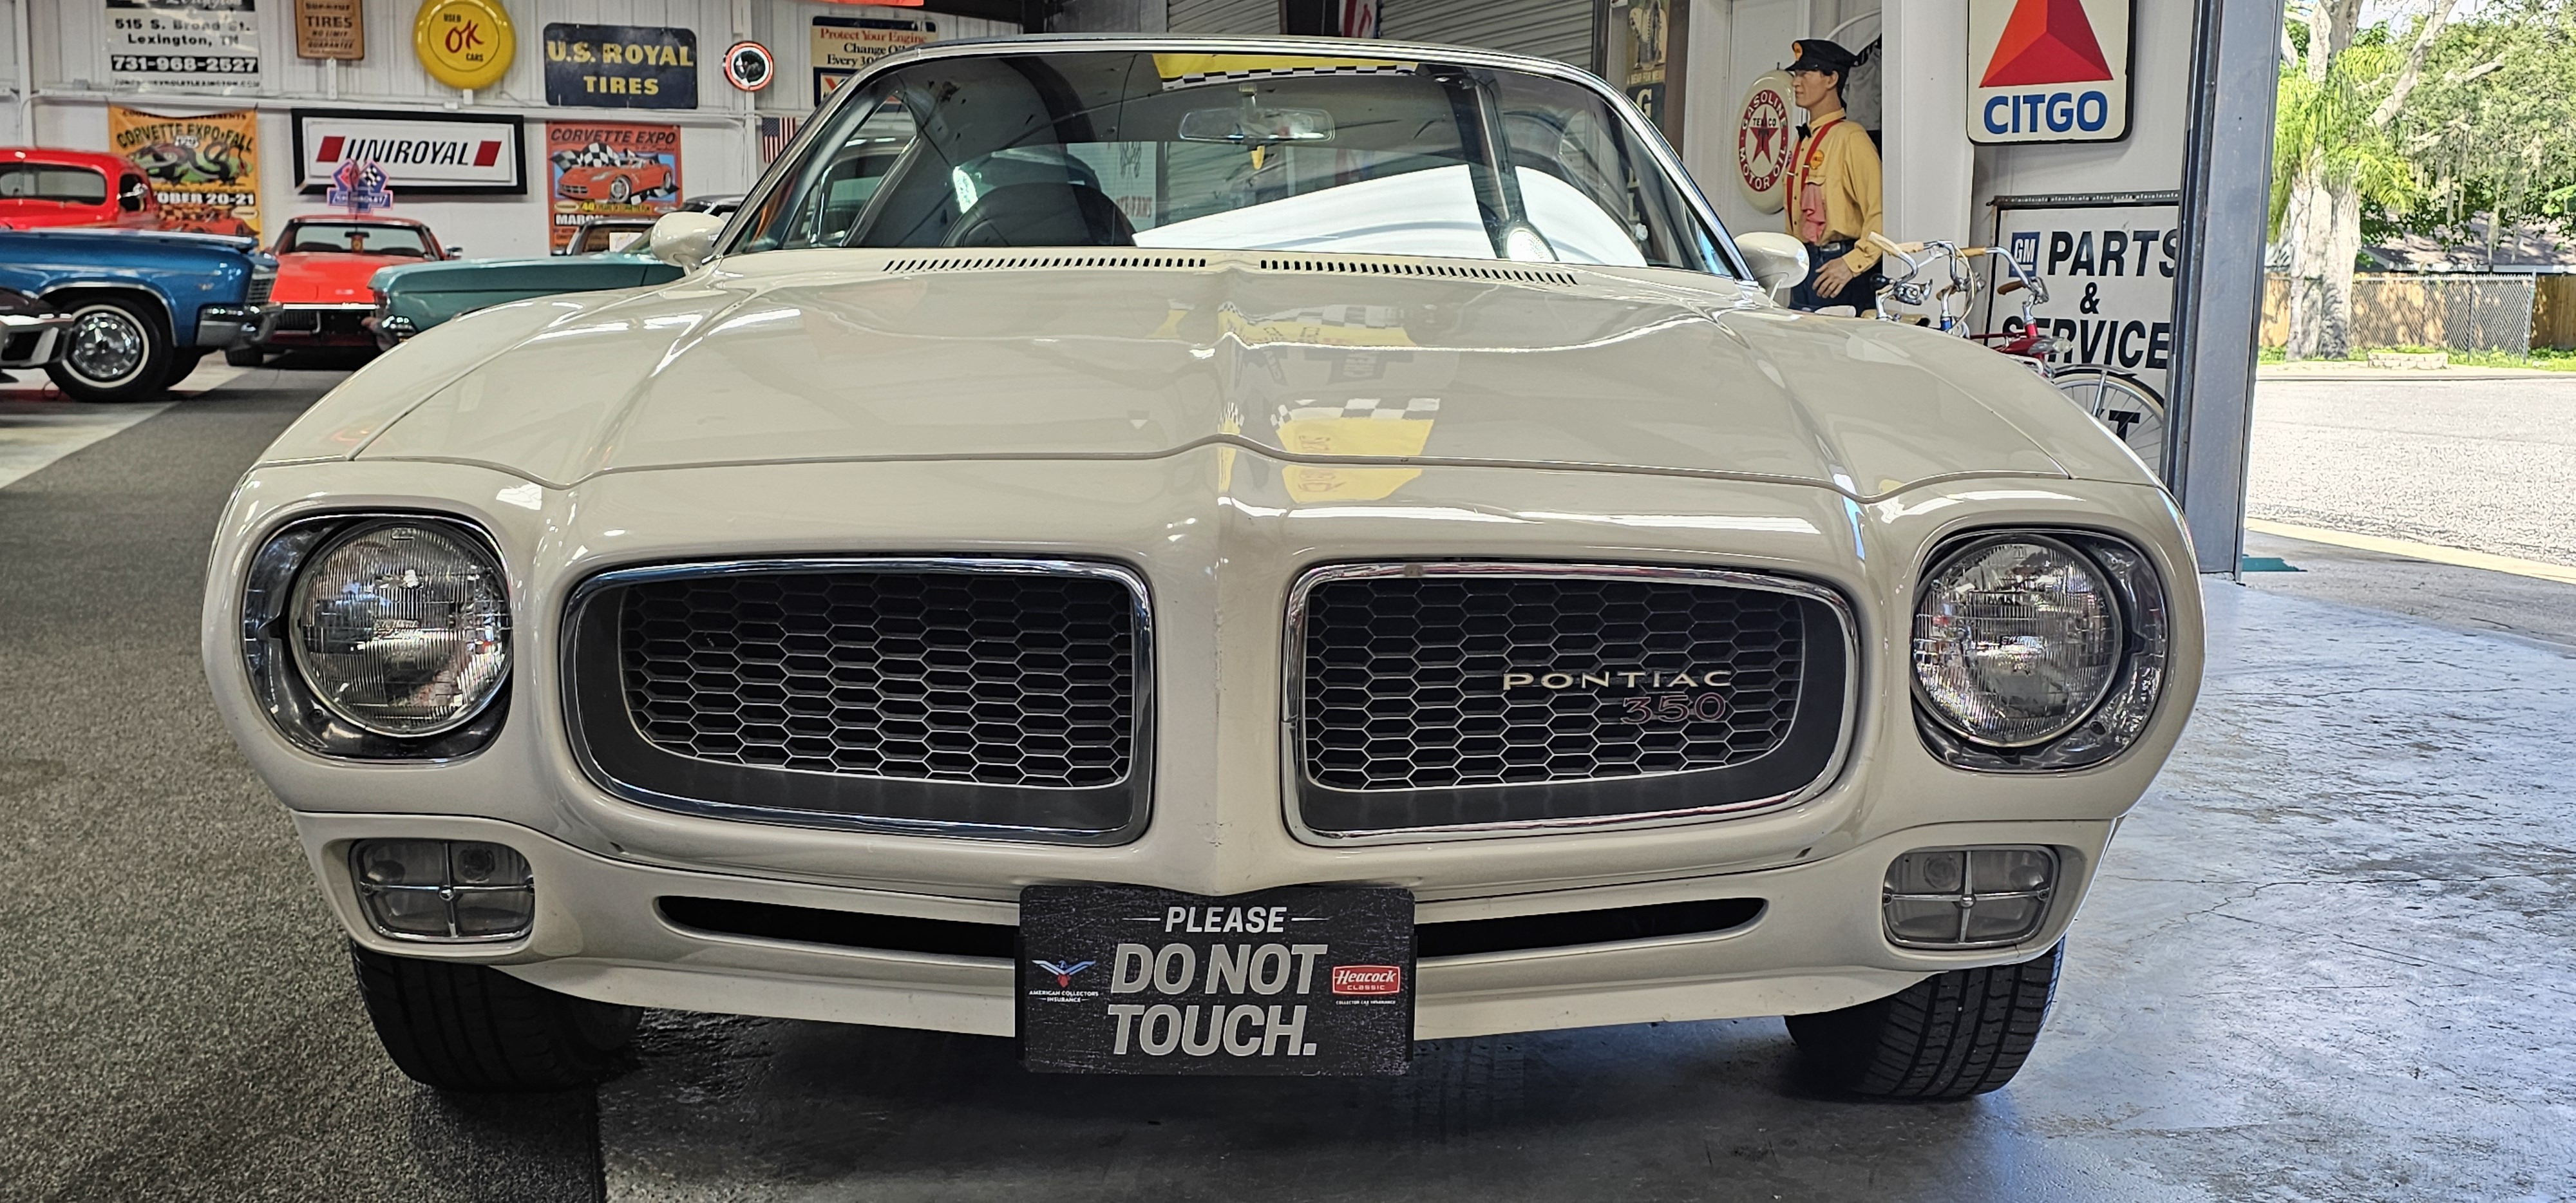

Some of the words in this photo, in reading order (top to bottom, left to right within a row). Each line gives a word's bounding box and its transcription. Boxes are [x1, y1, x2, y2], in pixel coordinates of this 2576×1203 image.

[115, 18, 142, 29] 515
[150, 19, 166, 30] S.
[305, 15, 352, 28] TIRES
[444, 14, 461, 23] USED
[128, 33, 213, 47] Lexington,
[445, 19, 484, 53] OK
[820, 28, 859, 41] Protect
[862, 31, 887, 41] Your
[889, 32, 927, 44] Engine
[466, 53, 484, 62] CARS
[547, 40, 596, 62] U.S.
[603, 43, 694, 66] ROYAL
[844, 43, 886, 55] Change
[113, 57, 256, 71] 731-968-2527
[828, 54, 858, 66] Every
[583, 75, 659, 95] TIRES
[1742, 91, 1787, 130] GASOLINE
[1984, 91, 2108, 135] CITGO
[117, 122, 182, 148] CORVETTE
[551, 128, 632, 143] CORVETTE
[635, 130, 676, 145] EXPO
[346, 138, 469, 166] UNIROYAL
[1739, 146, 1770, 190] MOTOR
[1773, 146, 1786, 178] OIL
[156, 193, 203, 204] OBER
[206, 193, 254, 205] 20-21
[582, 202, 595, 212] 40
[2014, 238, 2036, 263] GM
[2047, 230, 2177, 278] PARTS
[2079, 281, 2100, 314] &
[2002, 316, 2170, 370] RVICE
[1503, 670, 1731, 690] PONTIAC
[1620, 692, 1726, 725] 350
[1165, 907, 1287, 933] PLEASE
[1111, 943, 1196, 994] DO
[1204, 944, 1328, 994] NOT
[1336, 970, 1397, 985] Heacock
[1108, 1005, 1317, 1056] TOUCH.
